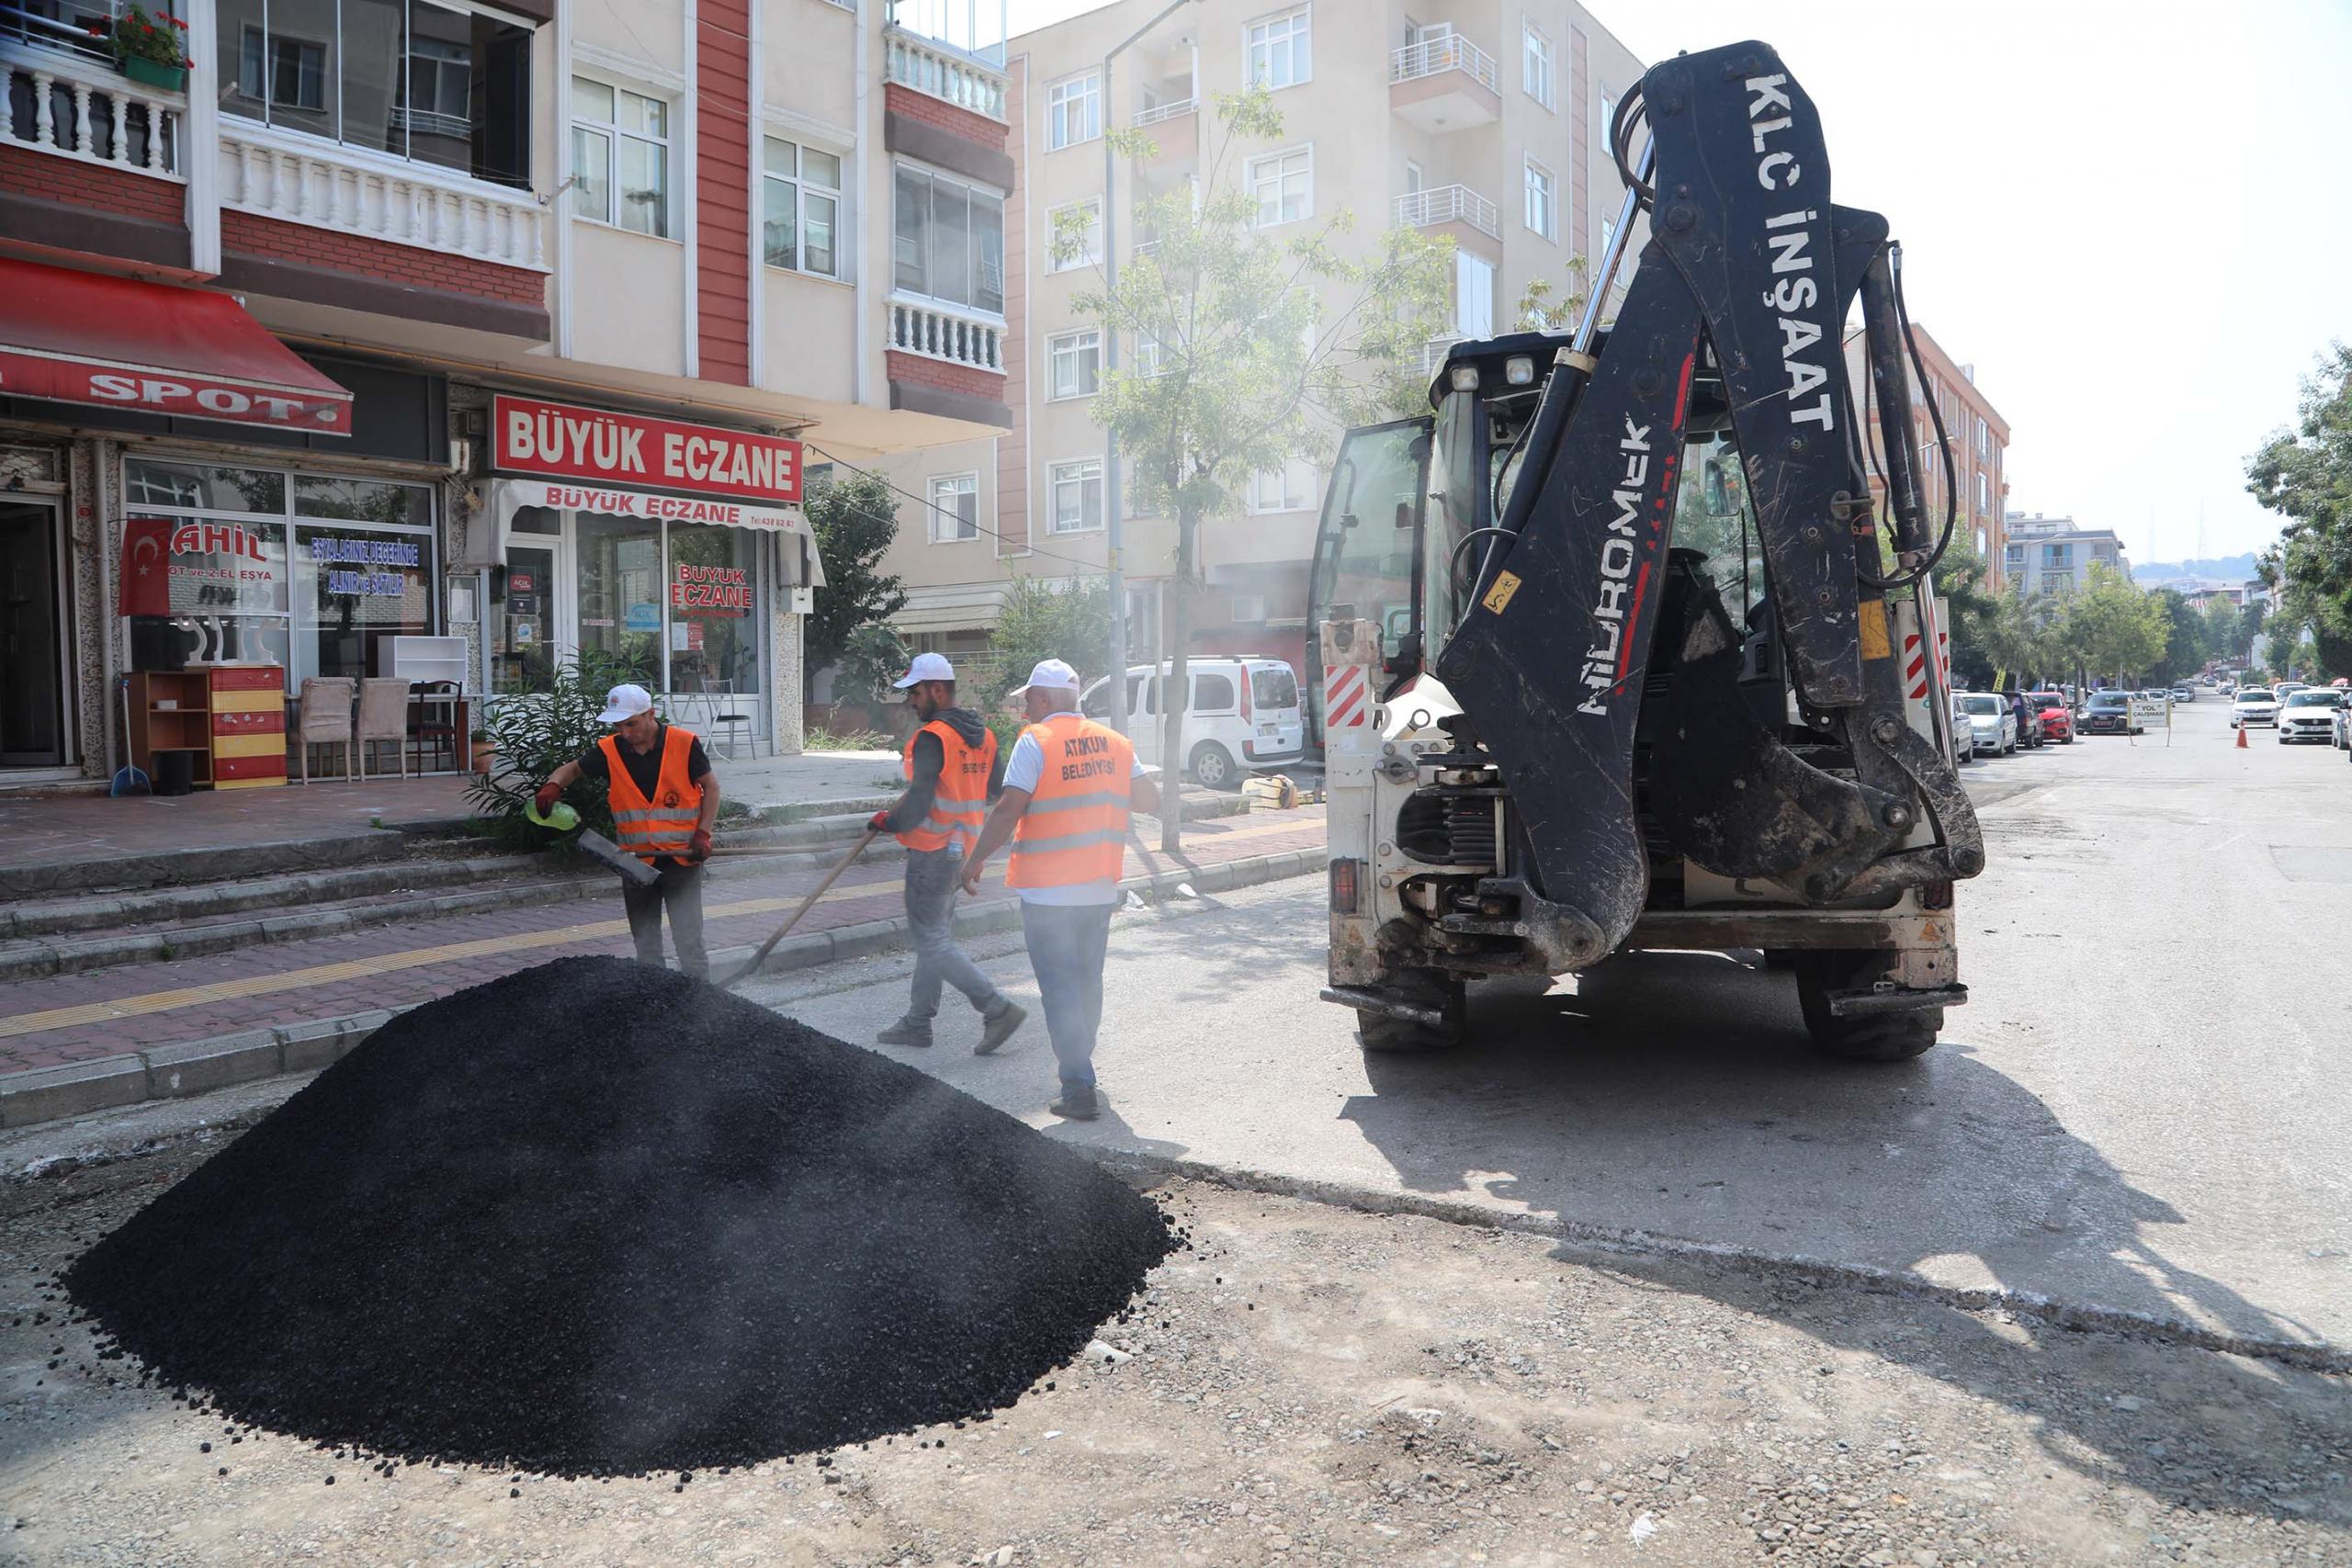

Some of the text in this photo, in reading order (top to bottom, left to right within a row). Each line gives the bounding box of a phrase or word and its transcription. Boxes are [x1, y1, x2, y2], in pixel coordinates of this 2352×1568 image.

[1746, 73, 1834, 432] KLC İNŞAAT
[90, 375, 303, 420] SPOT
[508, 409, 793, 491] BÜYÜK ECZANE
[546, 487, 634, 513] BÜYÜK
[646, 497, 741, 524] ECZANE
[170, 523, 268, 562] AHİL
[190, 569, 205, 577] ve
[240, 570, 272, 581] EŞYA
[328, 570, 358, 594] ALINIR
[679, 564, 746, 585] BÜYÜK
[671, 582, 752, 608] ECZANE
